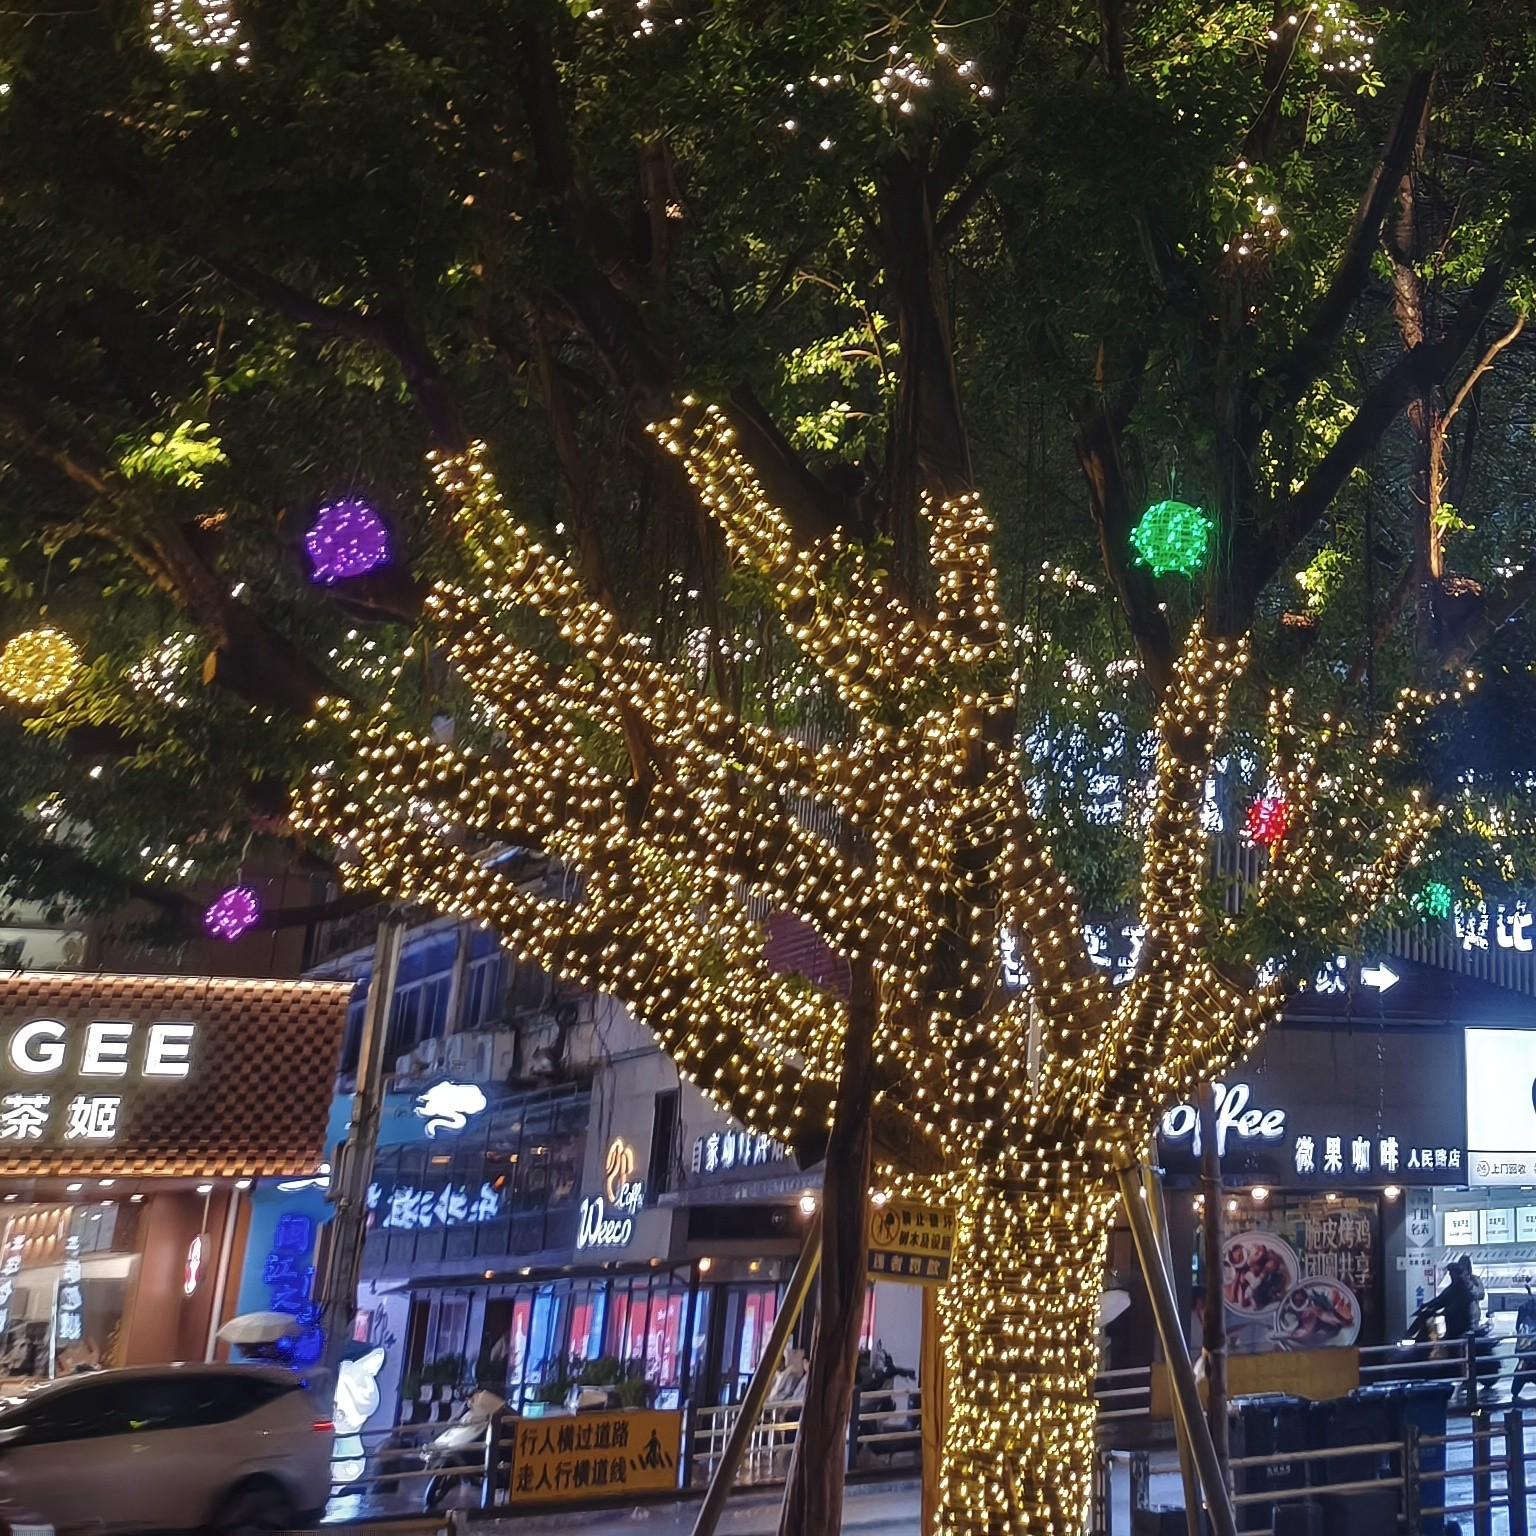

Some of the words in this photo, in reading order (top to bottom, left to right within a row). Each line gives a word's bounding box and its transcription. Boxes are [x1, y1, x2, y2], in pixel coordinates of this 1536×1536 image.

[9, 1019, 196, 1077] GEE
[0, 1095, 121, 1140] 茶姬
[1407, 1148, 1461, 1169] 人民路店
[520, 1419, 630, 1456] 行人横过道路
[516, 1456, 628, 1492] 走人行横道线
